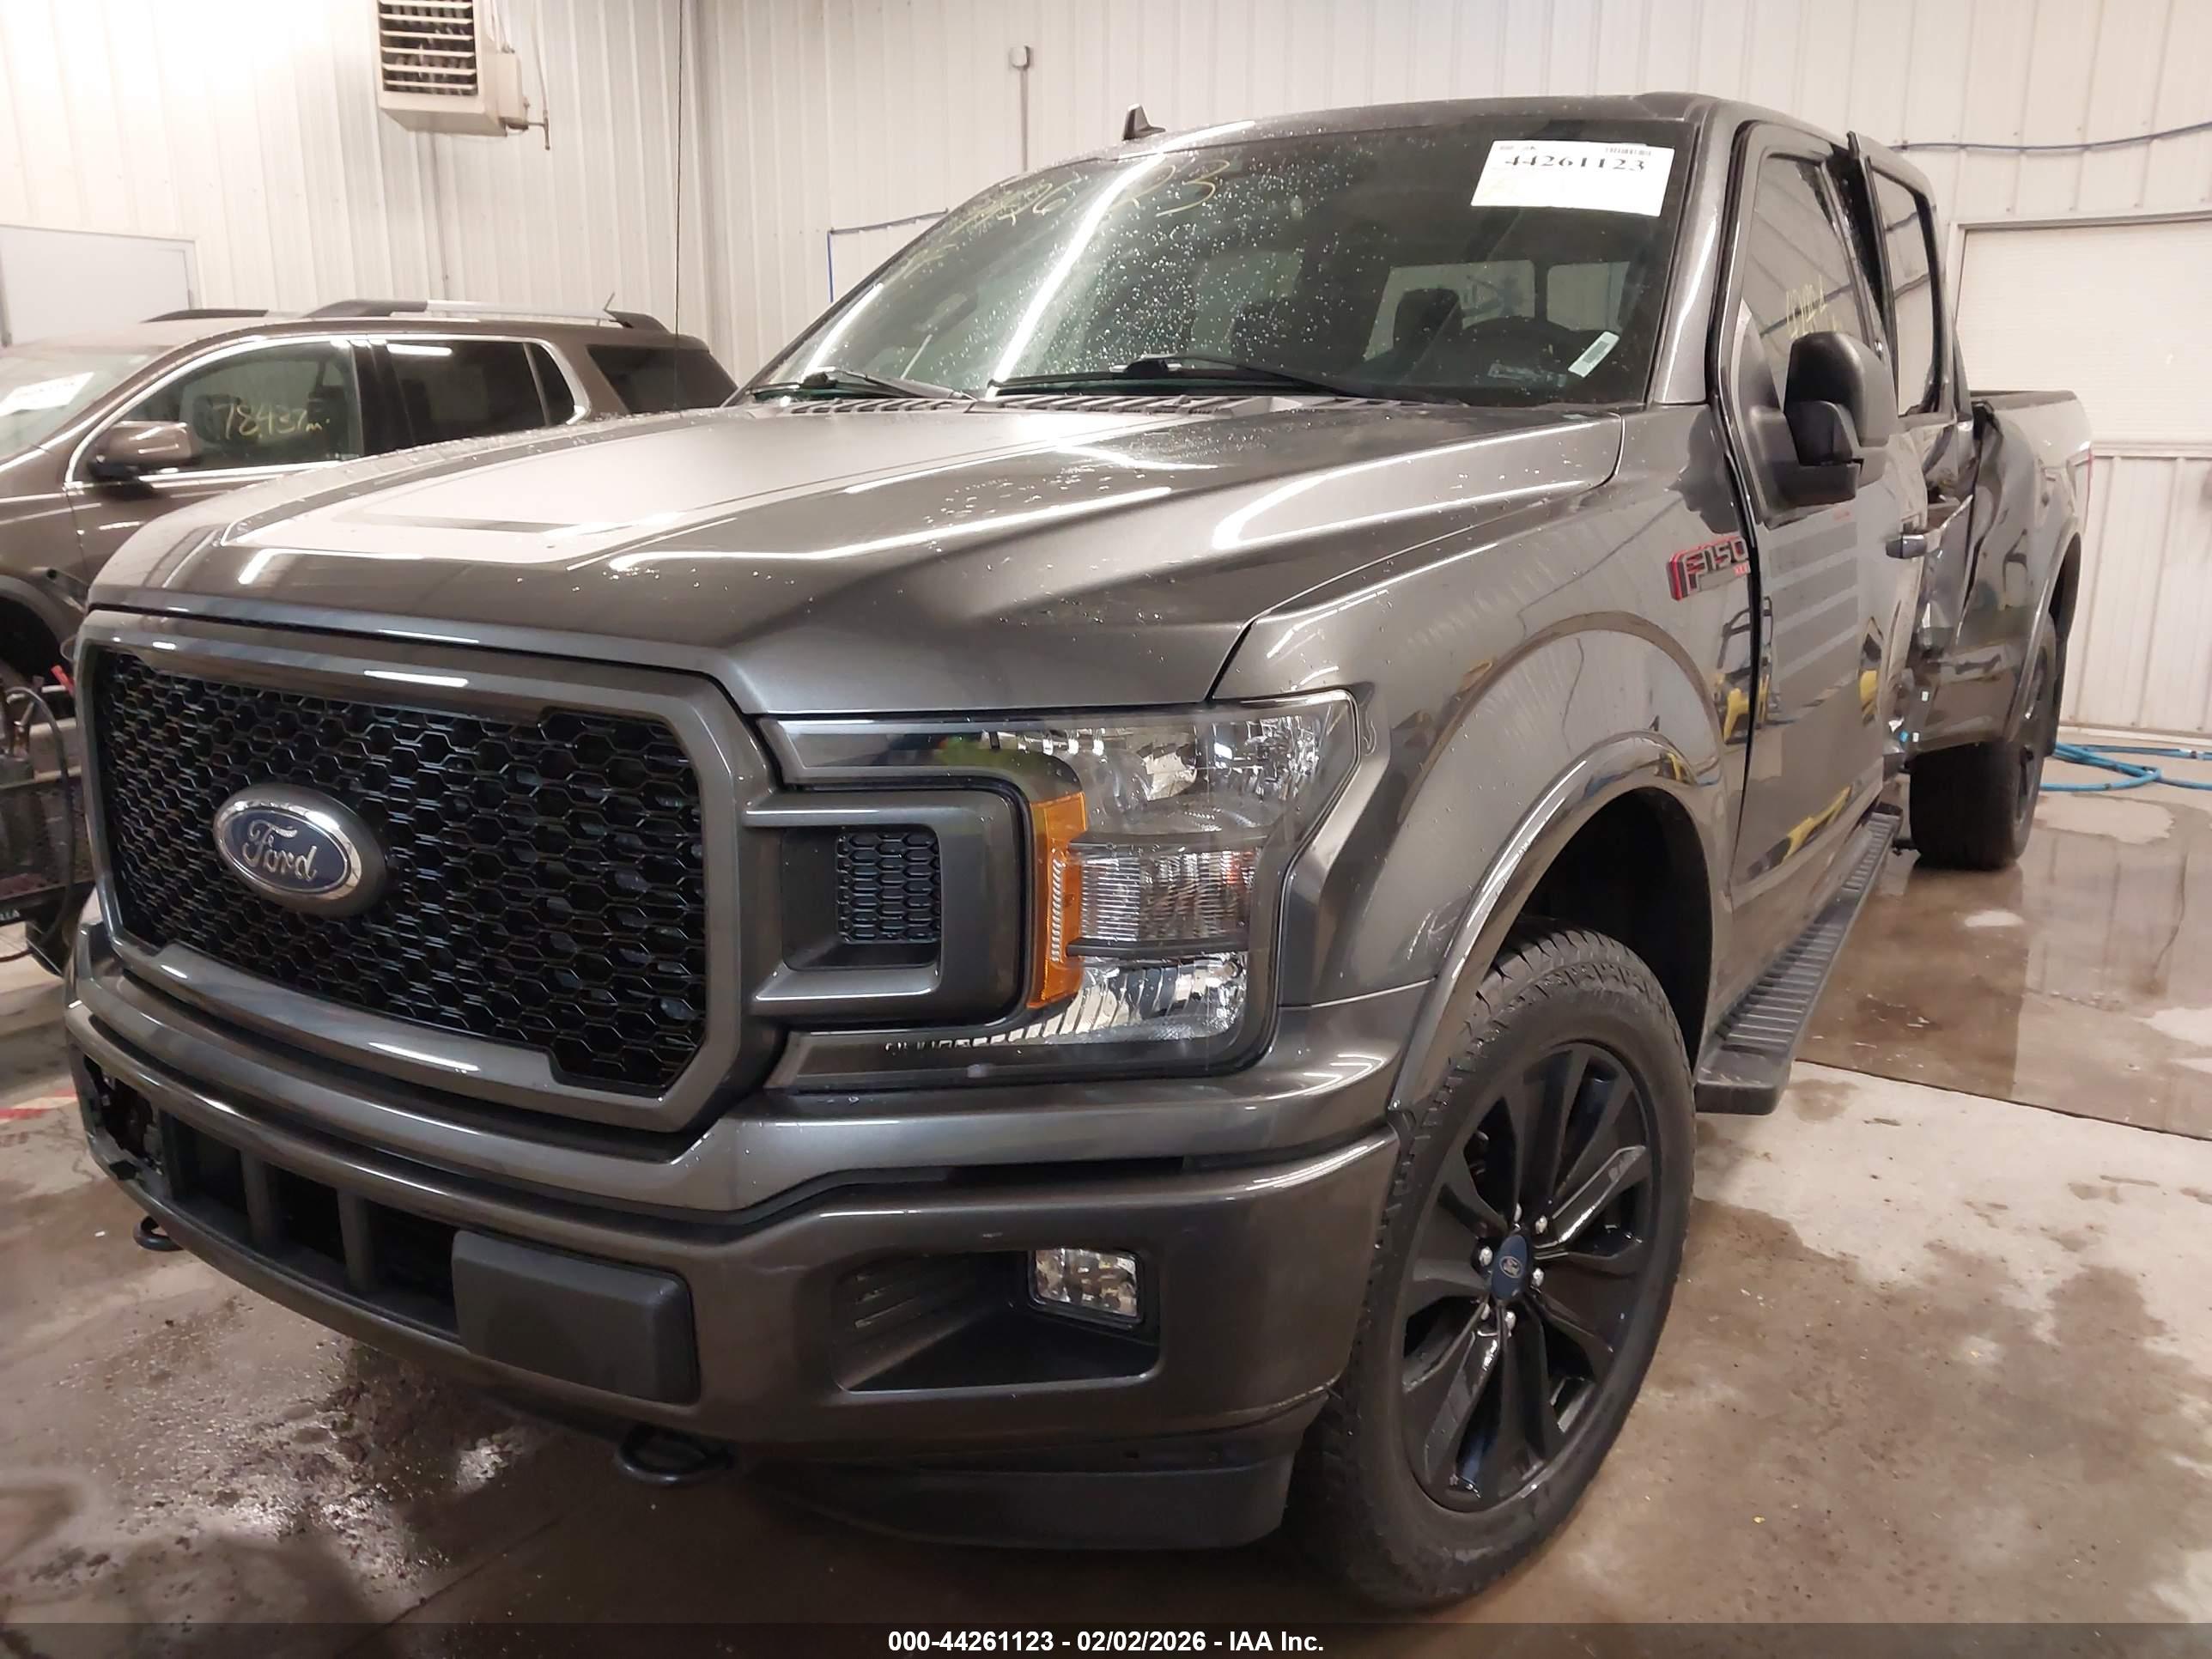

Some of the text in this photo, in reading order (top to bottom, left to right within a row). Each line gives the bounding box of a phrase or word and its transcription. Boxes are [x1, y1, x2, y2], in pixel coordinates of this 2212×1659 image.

[1505, 155, 1645, 172] 44261123
[1683, 537, 1749, 594] F150
[241, 818, 318, 883] Ford
